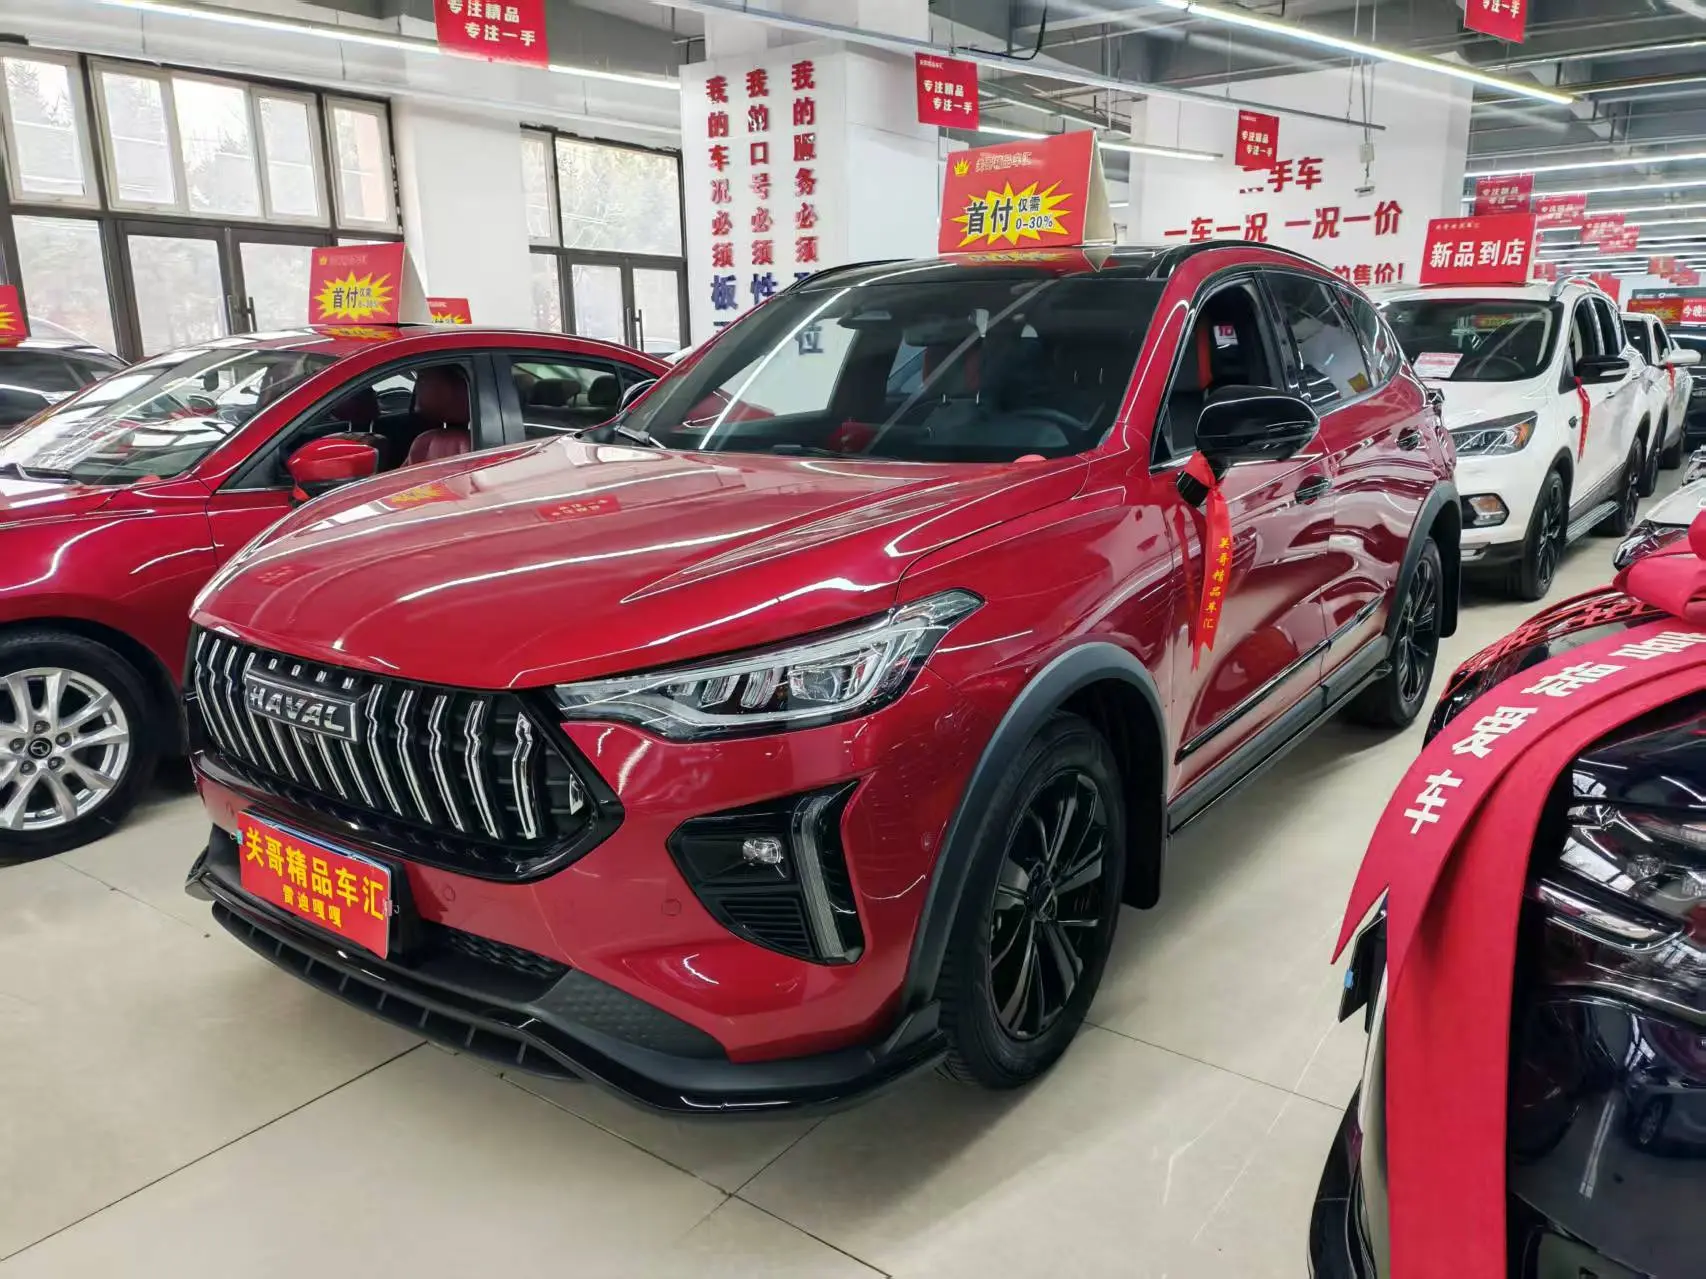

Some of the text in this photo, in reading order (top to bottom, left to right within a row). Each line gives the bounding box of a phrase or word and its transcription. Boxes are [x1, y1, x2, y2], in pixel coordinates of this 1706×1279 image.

[464, 22, 536, 47] 专注一手
[706, 75, 738, 332] 我的车况必须板
[966, 198, 1015, 235] 首付
[1018, 196, 1041, 212] 仅需
[1015, 215, 1054, 230] 0-30%
[1164, 200, 1403, 243] 一车一况 一况一价
[1430, 238, 1526, 268] 新品到店
[332, 286, 359, 309] 首付
[249, 683, 346, 733] HAVAL
[245, 826, 385, 921] 关哥精品车汇
